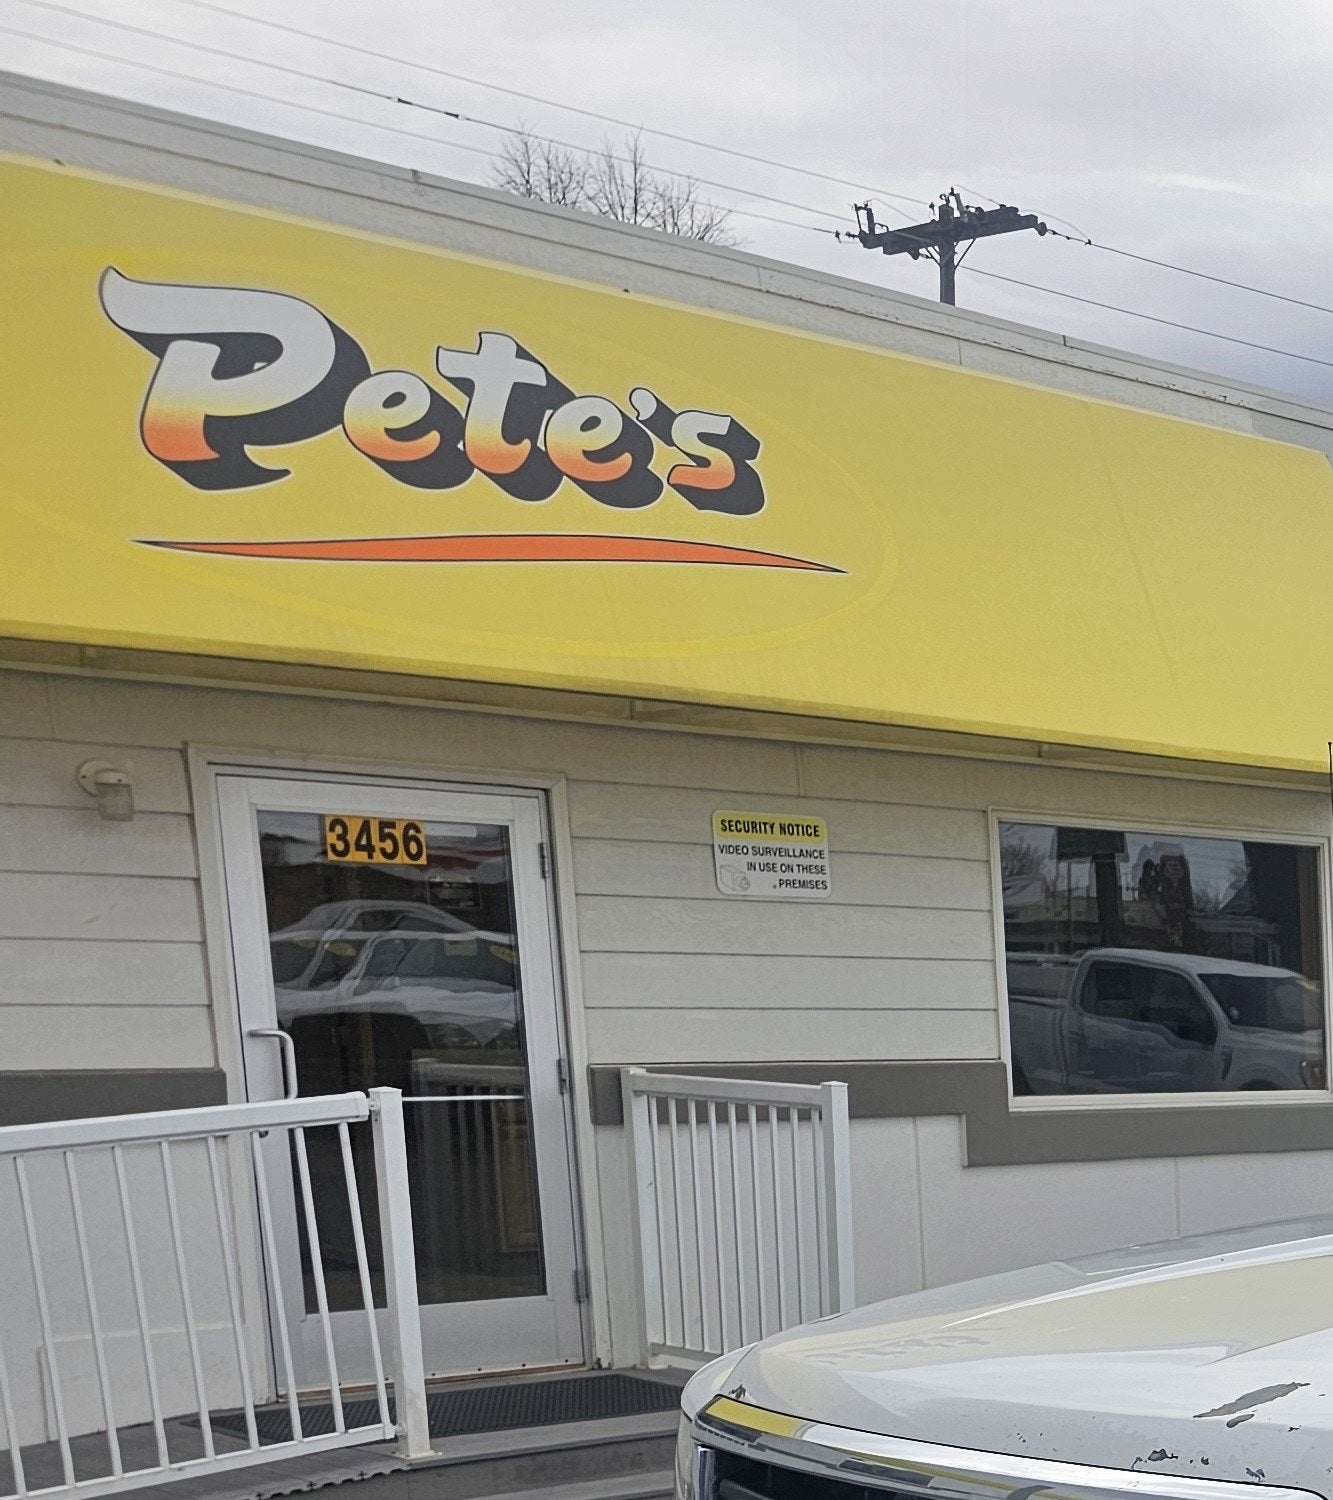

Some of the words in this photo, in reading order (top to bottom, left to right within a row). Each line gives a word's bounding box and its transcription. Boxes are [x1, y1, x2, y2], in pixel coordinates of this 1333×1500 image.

[98, 264, 765, 516] Pete's
[720, 819, 775, 835] SECURITY
[778, 823, 820, 837] NOTICE
[328, 817, 424, 862] 3456
[718, 843, 749, 855] VIDEO
[751, 845, 826, 859] SURVEILLANCE
[746, 861, 756, 871] IN
[758, 862, 778, 872] USE
[780, 863, 794, 873] ON
[796, 864, 827, 875] THESE
[778, 879, 828, 890] PREMISES
